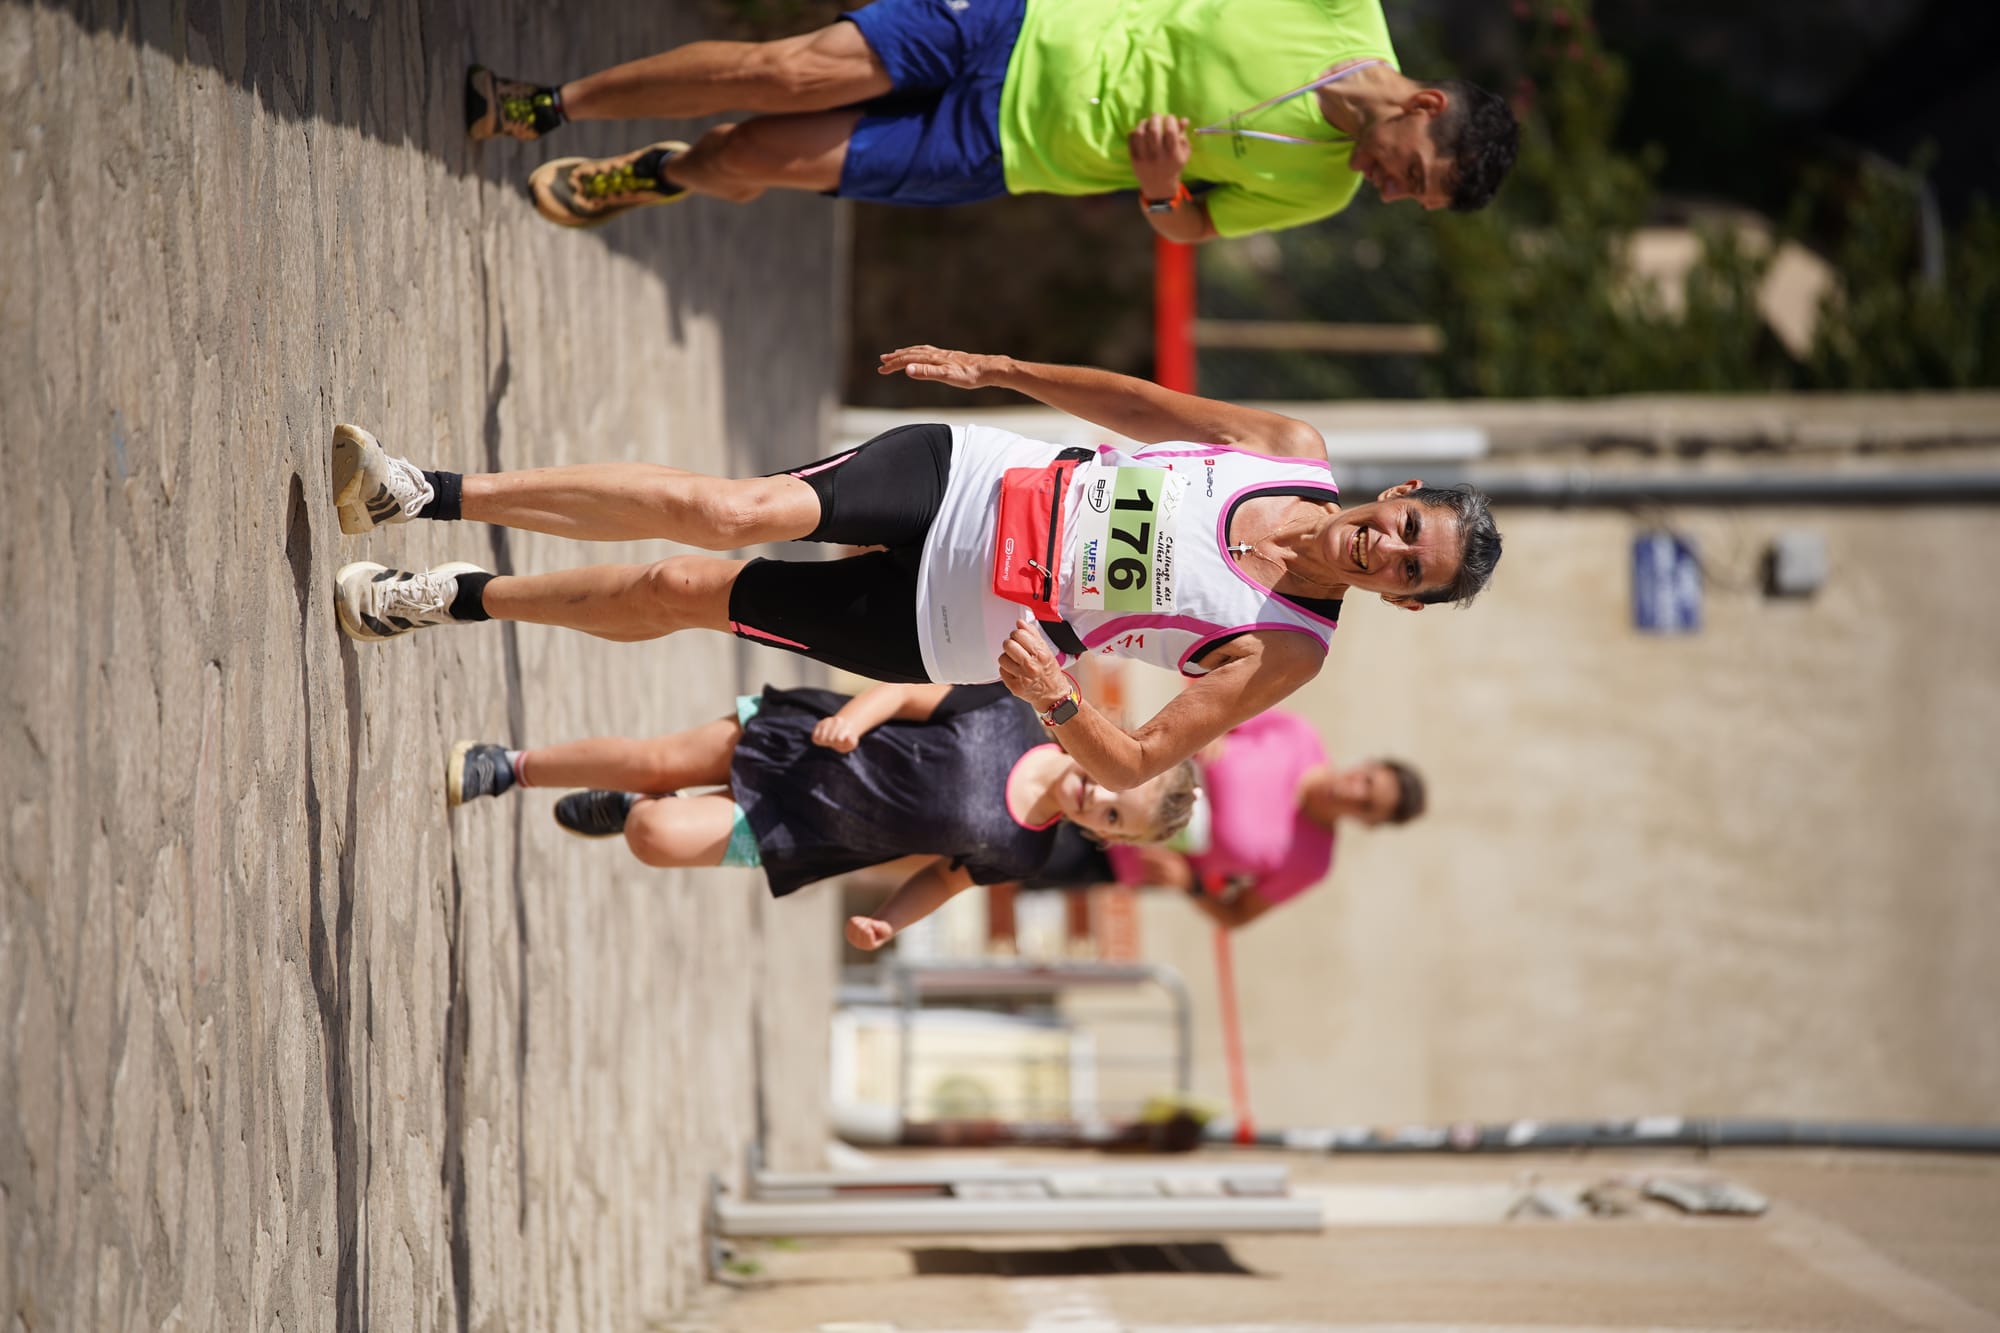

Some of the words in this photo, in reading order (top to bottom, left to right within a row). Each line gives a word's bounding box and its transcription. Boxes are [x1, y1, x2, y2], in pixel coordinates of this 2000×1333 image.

[1094, 479, 1106, 508] BFP
[1088, 539, 1098, 582] TUFF'S
[1107, 489, 1154, 591] 176
[1157, 530, 1165, 563] vallées
[1162, 536, 1173, 582] Challenge
[1082, 542, 1091, 587] Aventure
[1156, 567, 1164, 607] cévenoles
